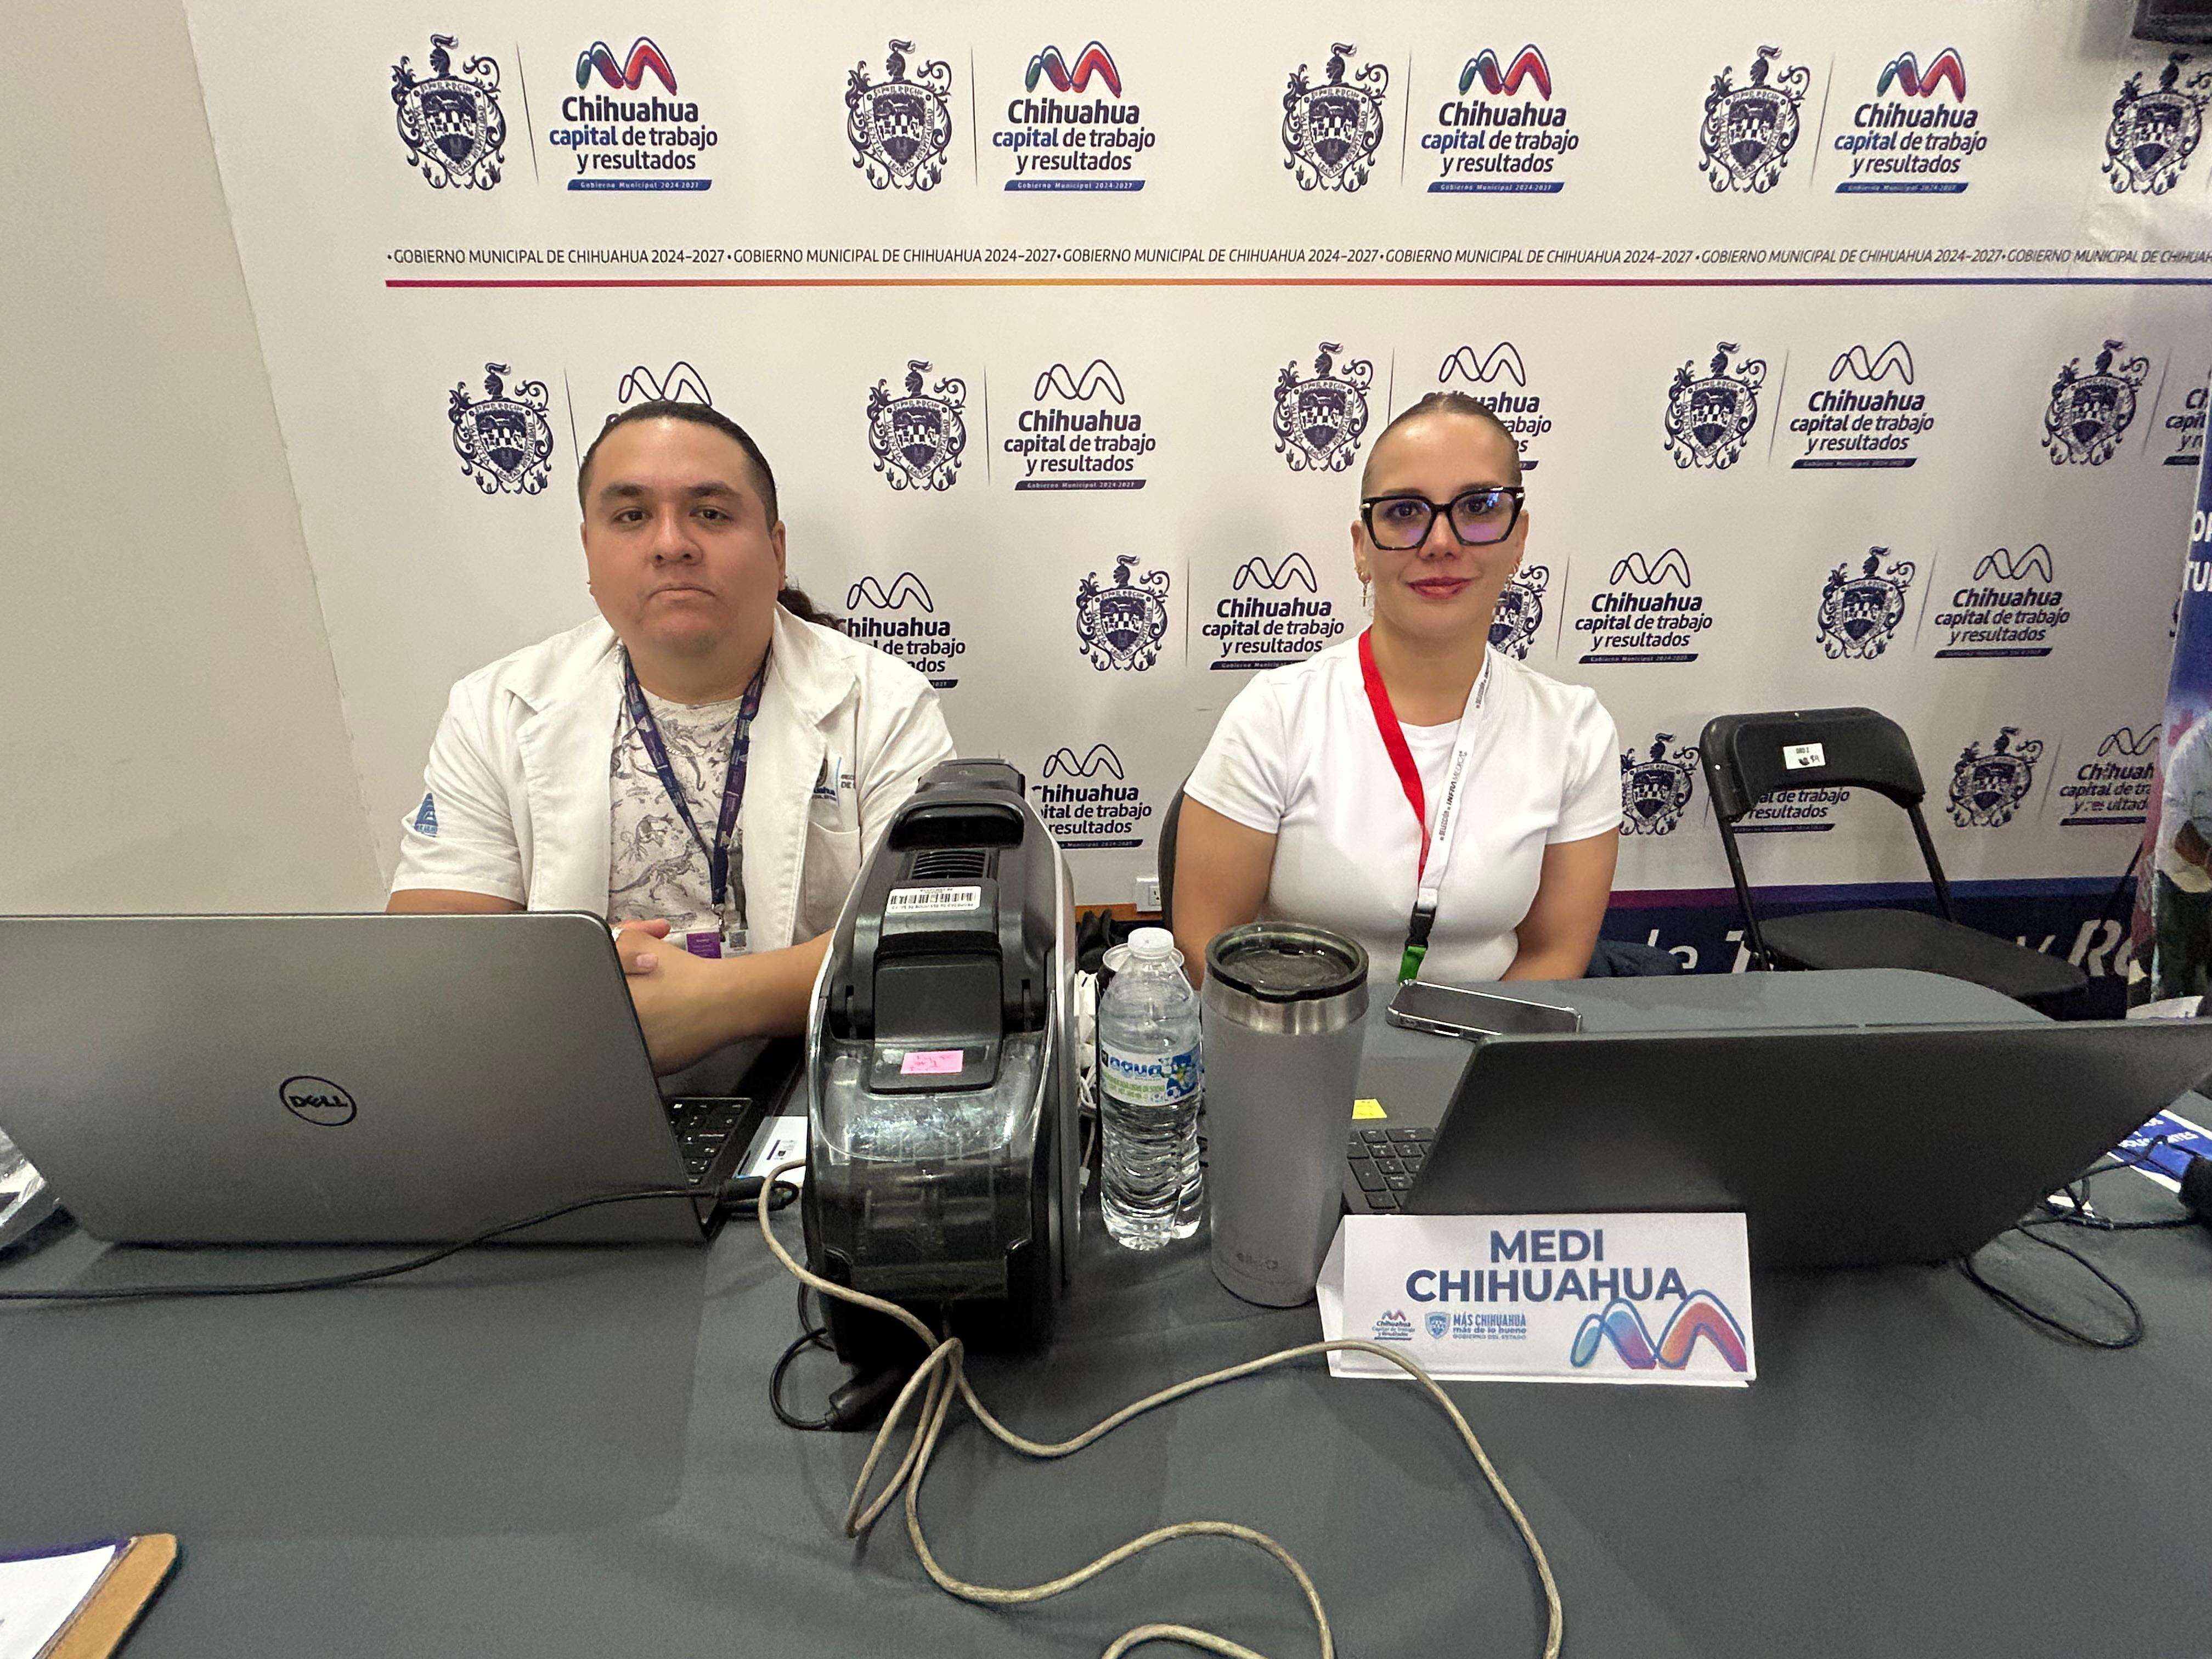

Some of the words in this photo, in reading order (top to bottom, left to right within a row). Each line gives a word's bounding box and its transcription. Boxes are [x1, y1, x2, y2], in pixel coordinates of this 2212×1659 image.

[562, 95, 698, 122] Chihuahua
[1008, 98, 1139, 124] Chihuahua
[1439, 100, 1566, 127] Chihuahua
[1854, 102, 1978, 128] Chihuahua
[550, 125, 618, 151] capital
[622, 126, 646, 146] de
[649, 125, 717, 151] trabajo
[992, 127, 1058, 152] capital
[1063, 128, 1086, 147] de
[1089, 127, 1155, 152] trabajo
[1421, 129, 1485, 154] capital
[1489, 130, 1511, 149] de
[1515, 129, 1579, 155] trabajo
[1835, 131, 1898, 155] capital
[1900, 131, 1922, 150] de
[1925, 131, 1988, 155] trabajo
[577, 154, 588, 174] y
[593, 150, 696, 170] resultados
[1016, 155, 1028, 175] y
[1032, 151, 1131, 170] resultados
[1440, 157, 1454, 177] y
[1457, 153, 1554, 172] resultados
[1849, 158, 1865, 178] y
[1865, 154, 1961, 173] resultados
[394, 250, 465, 263] GOBIERNO
[470, 250, 544, 263] MUNICIPAL
[547, 250, 565, 263] DE
[568, 250, 648, 263] CHIHUAHUA
[652, 250, 724, 263] 2024-2027
[734, 250, 803, 263] GOBIERNO
[807, 249, 879, 262] MUNICIPAL
[883, 249, 900, 262] DE
[904, 249, 981, 262] CHIHUAHUA
[985, 249, 1057, 262] 2024-2027
[1064, 249, 1131, 262] GOBIERNO
[1135, 249, 1205, 262] MUNICIPAL
[1209, 249, 1226, 262] DE
[1229, 249, 1305, 262] CHIHUAHUA
[1308, 249, 1379, 262] 2024-2027
[1386, 250, 1452, 262] GOBIERNO
[1455, 250, 1523, 263] MUNICIPAL
[1527, 250, 1544, 263] DE
[1547, 250, 1620, 263] CHIHUAHUA
[1623, 250, 1694, 263] 2024-2027
[1702, 250, 1767, 263] GOBIERNO
[1768, 250, 1836, 263] MUNICIPAL
[1839, 250, 1858, 263] DE
[1859, 250, 1932, 263] CHIHUAHUA
[1934, 249, 2003, 262] 2024-2027
[2007, 249, 2073, 262] GOBIERNO
[2073, 250, 2138, 263] MUNICIPAL
[2141, 250, 2160, 263] DE
[2160, 250, 2212, 263] CHIHUAH
[1808, 390, 1925, 411] Chihuahua
[1019, 409, 1141, 432] Chihuahua
[1790, 414, 1849, 436] capital
[1852, 414, 1873, 431] de
[1876, 413, 1934, 435] trabajo
[1005, 434, 1065, 456] capital
[1069, 435, 1091, 452] de
[1094, 433, 1155, 455] trabajo
[1804, 438, 1819, 455] y
[1819, 433, 1910, 450] resultados
[1025, 459, 1037, 477] y
[1041, 455, 1133, 472] resultados
[1217, 597, 1331, 618] Chihuahua
[1592, 592, 1702, 612] Chihuahua
[1953, 587, 2063, 607] Chihuahua
[841, 618, 950, 637] hihuahua
[1203, 619, 1260, 640] capital
[1263, 620, 1283, 635] de
[1286, 618, 1344, 638] trabajo
[1575, 614, 1632, 634] capital
[1634, 614, 1655, 629] de
[1657, 613, 1712, 633] trabajo
[1935, 609, 1992, 629] capital
[1992, 609, 2013, 624] de
[2015, 607, 2070, 628] trabajo
[1221, 642, 1233, 658] y
[1235, 637, 1323, 653] resultados
[1590, 636, 1604, 652] y
[1605, 631, 1690, 647] resultados
[1947, 631, 1961, 646] y
[1961, 627, 2046, 642] resultados
[906, 638, 965, 658] trabajo
[2078, 762, 2154, 780] Chihuah
[1798, 787, 1849, 809] trabajo
[1041, 804, 1071, 819] ital
[1074, 804, 1093, 818] de
[1096, 802, 1152, 820] trabajo
[289, 1094, 348, 1107] DELL
[1491, 1229, 1604, 1263] MEDI
[1406, 1267, 1687, 1302] CHIHUAHUA
[1453, 1311, 1472, 1327] MÁS
[1475, 1313, 1526, 1327] CHIHUAHUA
